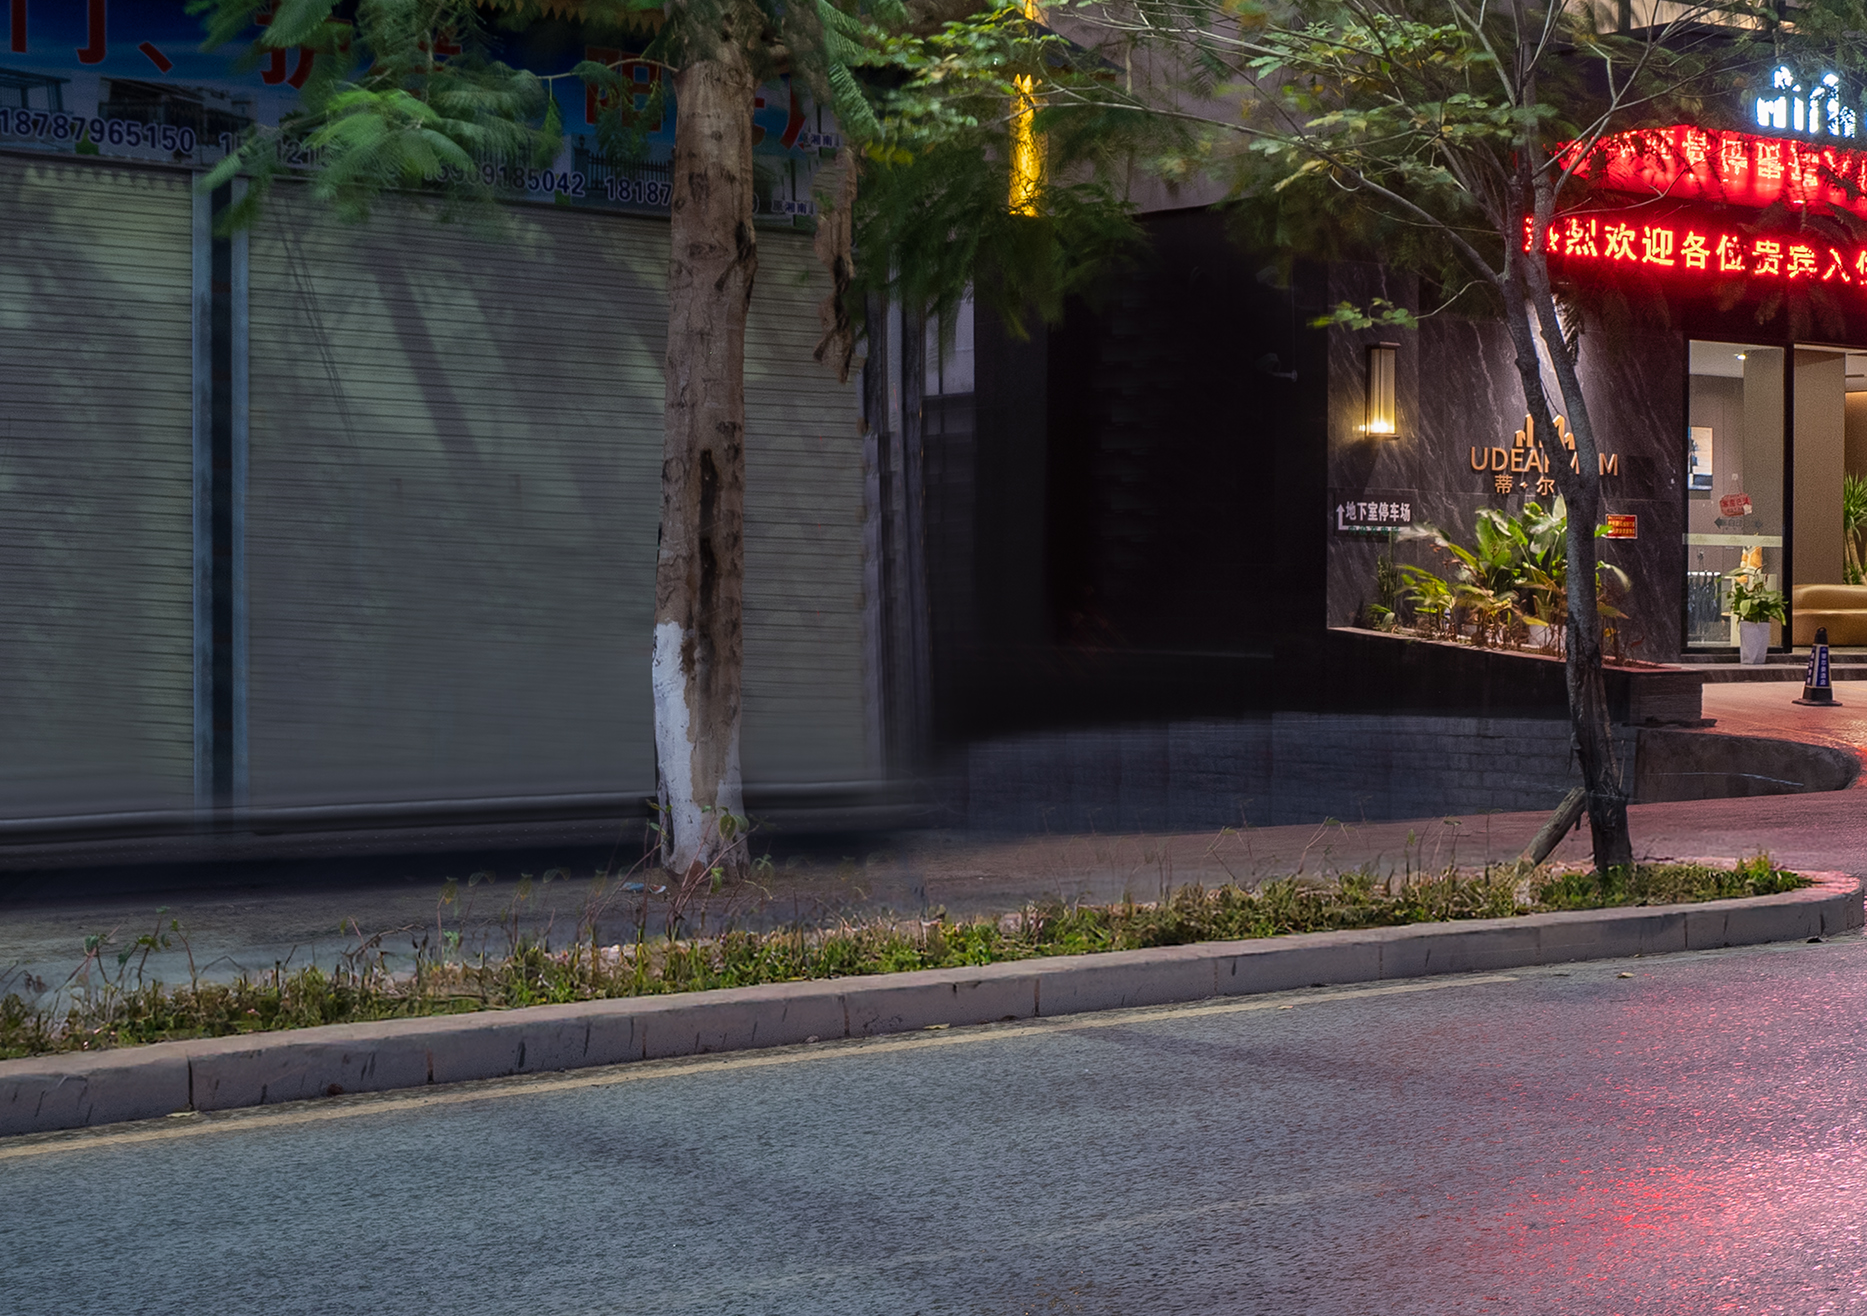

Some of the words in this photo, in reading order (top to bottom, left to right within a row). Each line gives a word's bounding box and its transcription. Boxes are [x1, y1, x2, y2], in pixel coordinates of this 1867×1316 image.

[0, 108, 197, 155] 18787965150
[1345, 501, 1411, 522] 地下室停车场
